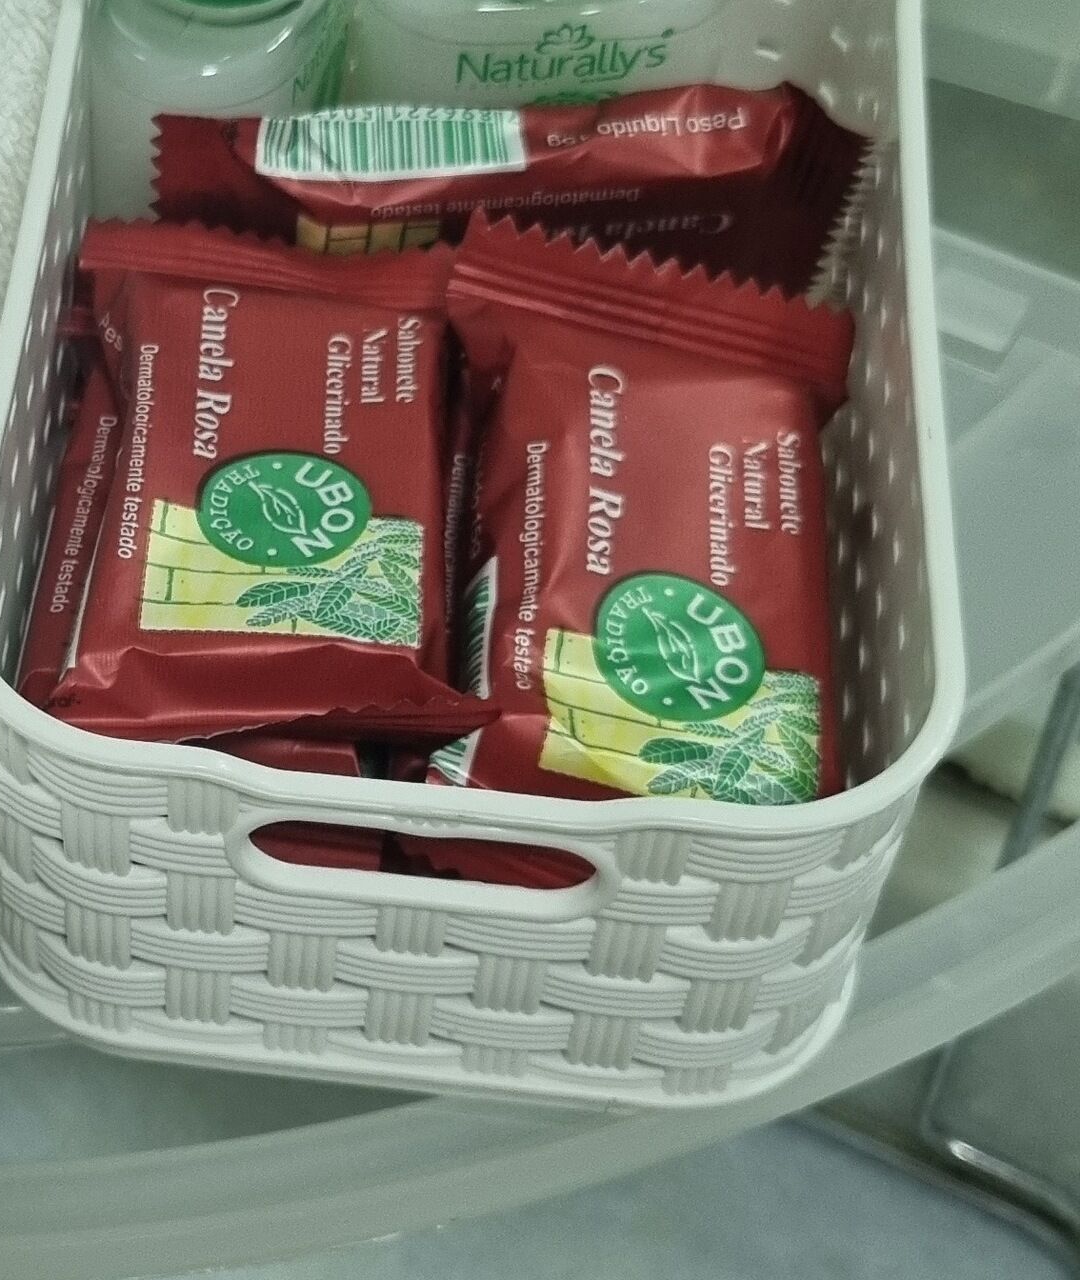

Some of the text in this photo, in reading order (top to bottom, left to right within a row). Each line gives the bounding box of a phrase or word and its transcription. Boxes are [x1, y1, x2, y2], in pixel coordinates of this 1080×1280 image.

[686, 107, 747, 130] Peso
[371, 202, 442, 220] testado
[193, 286, 240, 459] Canela Rosa
[322, 334, 353, 455] Glicerinado
[361, 328, 389, 404] Natural
[395, 315, 423, 404] Sabonete
[117, 344, 159, 560] Dermatologicamente testado
[209, 463, 262, 551] TRADIÇÃO
[586, 365, 625, 576] Canela Rosa
[743, 436, 771, 530] Natural
[775, 430, 802, 536] Sabonete
[50, 415, 118, 613] Dermatologicamente testado
[290, 461, 356, 558] UBON
[518, 440, 548, 622] Dermatologicamente
[709, 442, 737, 587] Glicerinado
[605, 586, 653, 696] TRADIÇÃO
[685, 592, 749, 710] UBON
